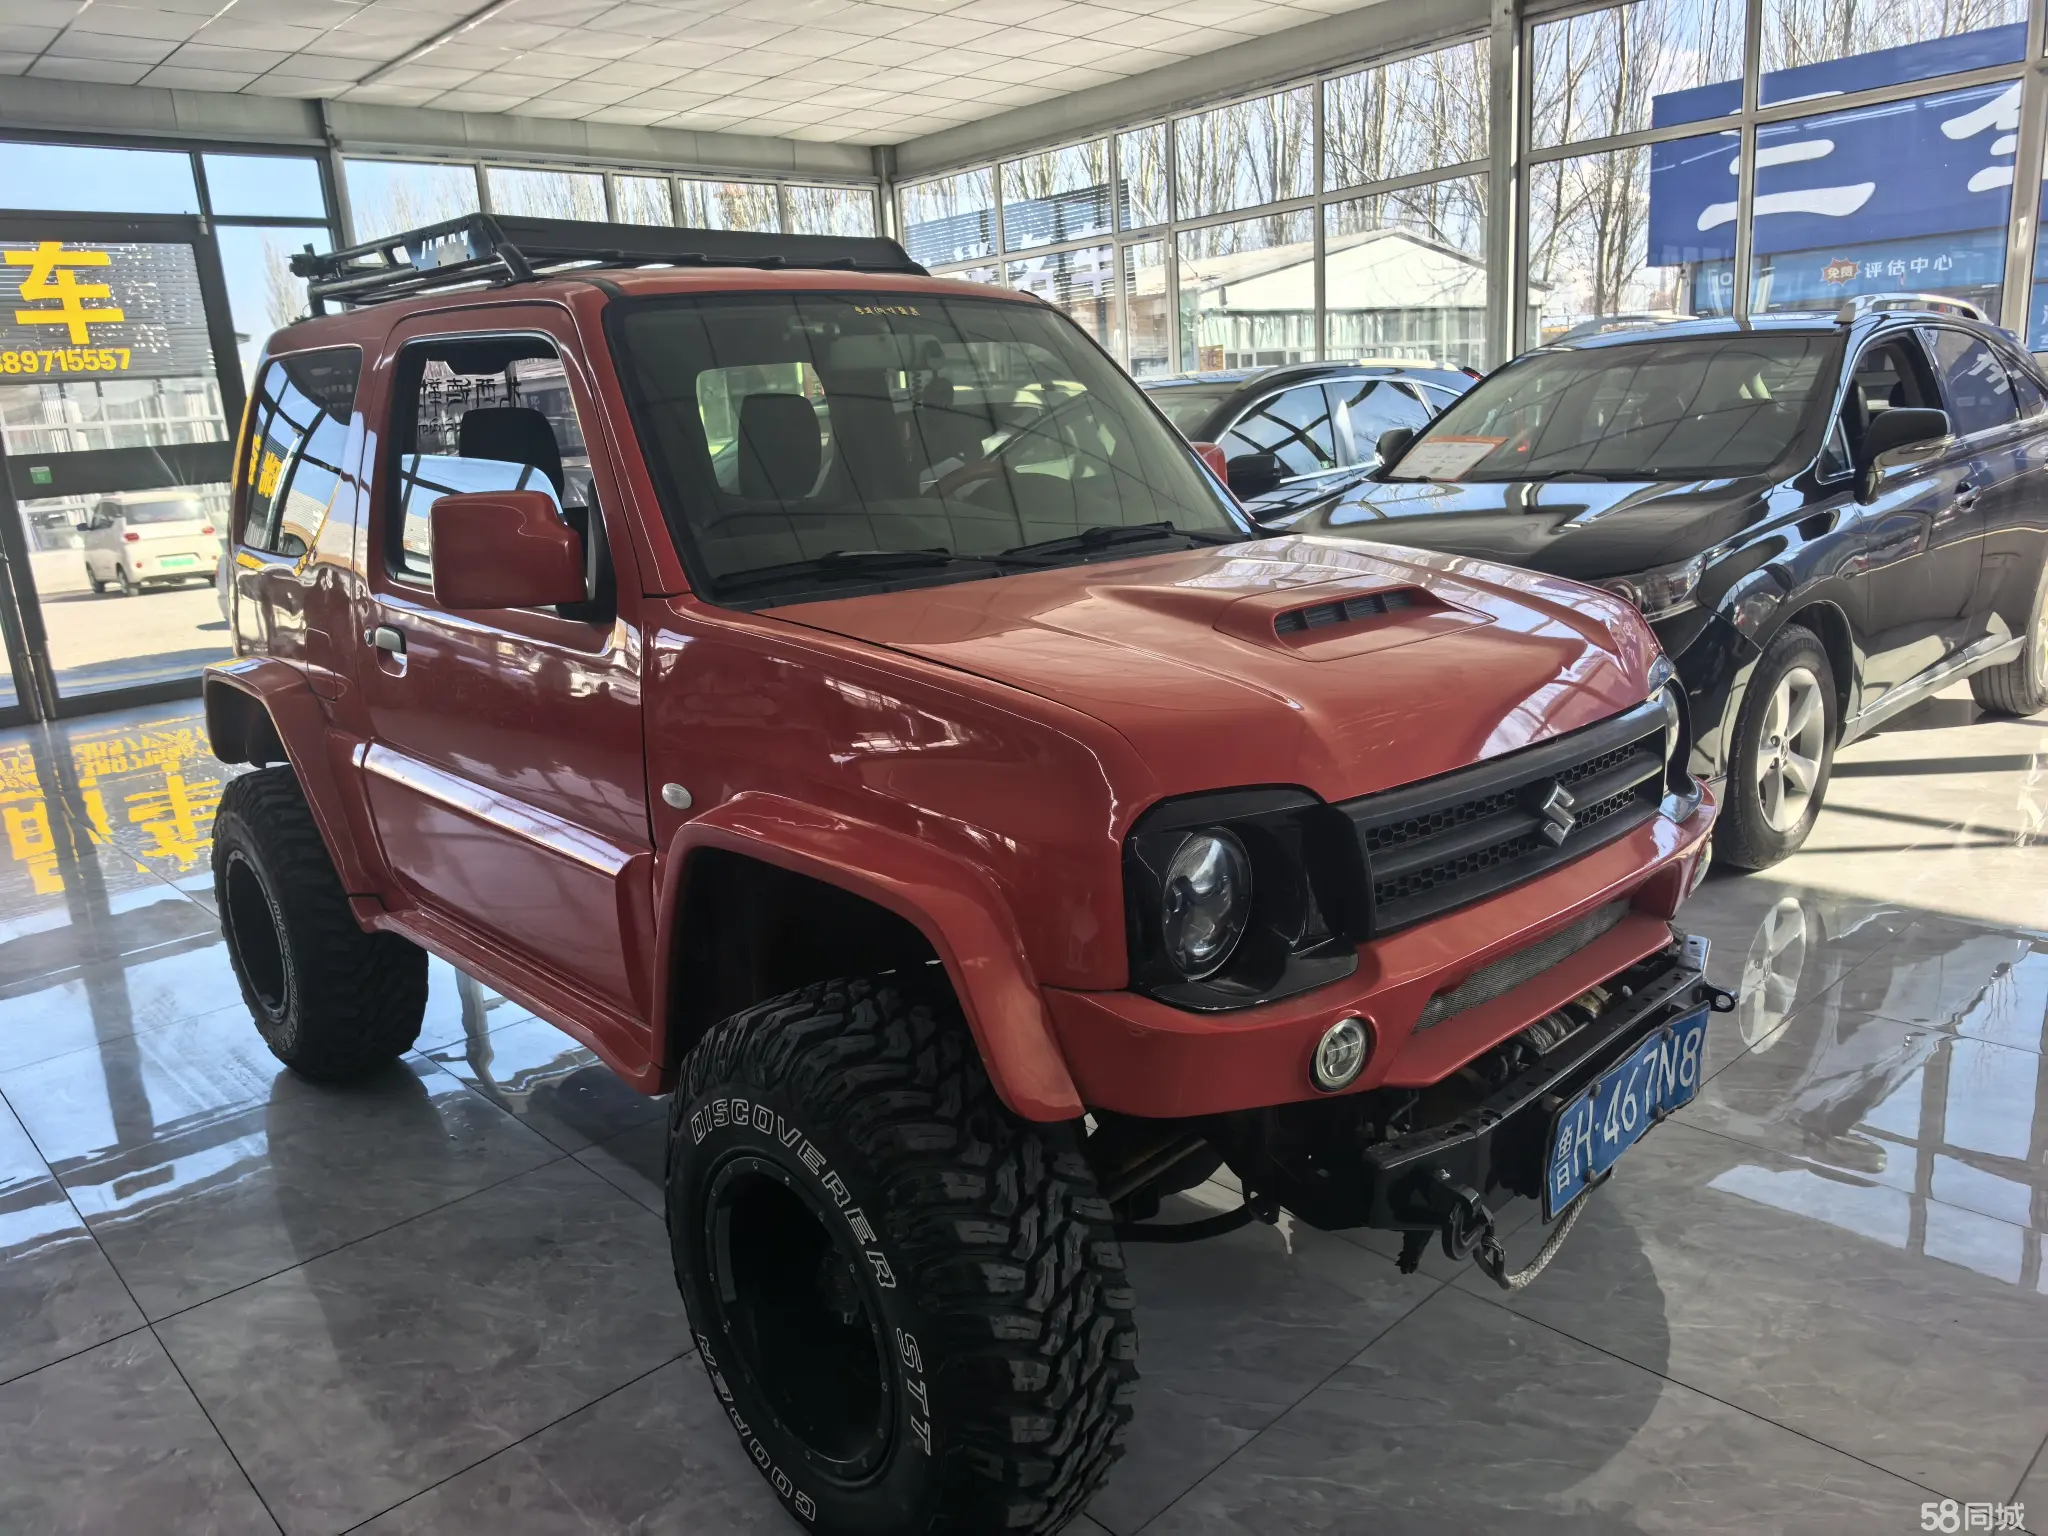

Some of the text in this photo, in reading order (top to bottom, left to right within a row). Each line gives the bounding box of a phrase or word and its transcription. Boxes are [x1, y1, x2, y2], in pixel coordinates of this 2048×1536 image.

[3, 241, 125, 345] 车
[1865, 254, 1953, 279] 评估中心
[690, 1098, 932, 1456] DISCOVERER STT
[696, 1333, 816, 1521] COOPER
